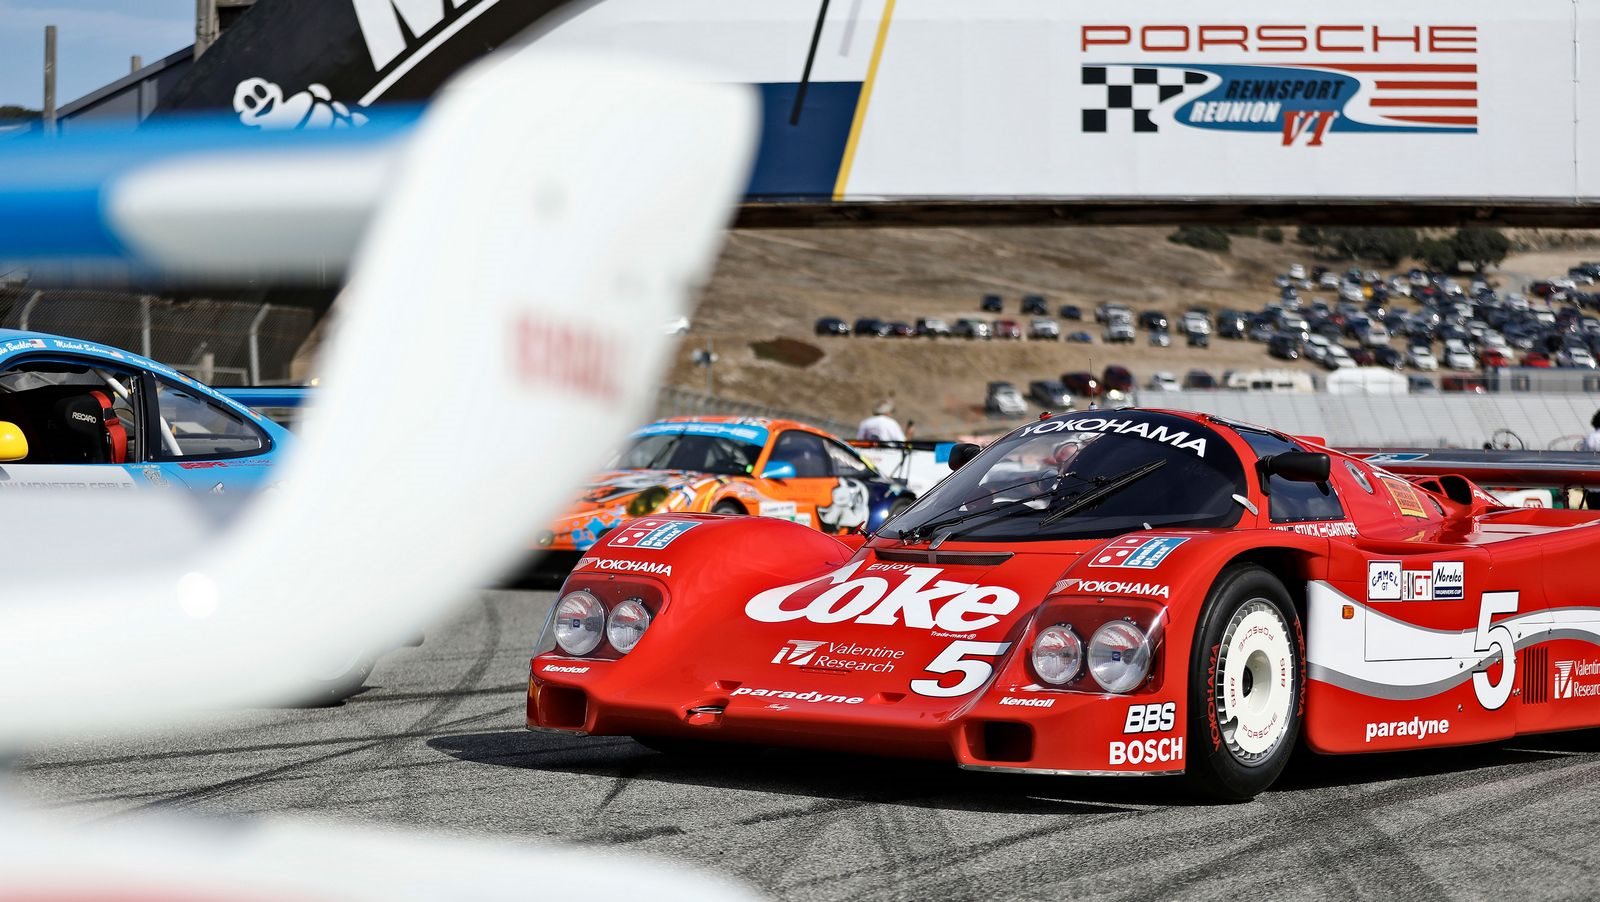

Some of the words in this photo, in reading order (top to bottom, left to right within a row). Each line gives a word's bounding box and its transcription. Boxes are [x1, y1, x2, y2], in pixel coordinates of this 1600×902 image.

[1081, 25, 1478, 53] PORSCHE
[1225, 79, 1346, 101] RENNSPORT
[1189, 101, 1281, 124] REUNION
[1281, 110, 1339, 147] VI
[72, 411, 97, 424] RECARO
[1021, 418, 1207, 458] YOKOHAMA
[594, 558, 672, 577] YOKOHAMA
[866, 563, 913, 573] Enjoy
[1434, 566, 1462, 585] Norelco
[1371, 570, 1399, 587] CAMEL
[1381, 582, 1389, 592] GT
[1414, 575, 1431, 596] GT
[744, 559, 1020, 633] Coke
[1077, 580, 1170, 599] YOKOHAMA
[828, 641, 905, 659] Valentine
[1472, 592, 1519, 710] 5
[541, 665, 590, 674] Kendall
[814, 655, 895, 673] Research
[910, 639, 1013, 698] 5
[732, 687, 864, 704] paradyne
[999, 696, 1056, 708] Kendall
[1207, 643, 1220, 752] YOKOHAMA
[1124, 701, 1176, 734] BBS
[1242, 711, 1278, 739] PORSCHE
[1365, 716, 1450, 743] paradyne
[1109, 736, 1183, 766] BOSCH
